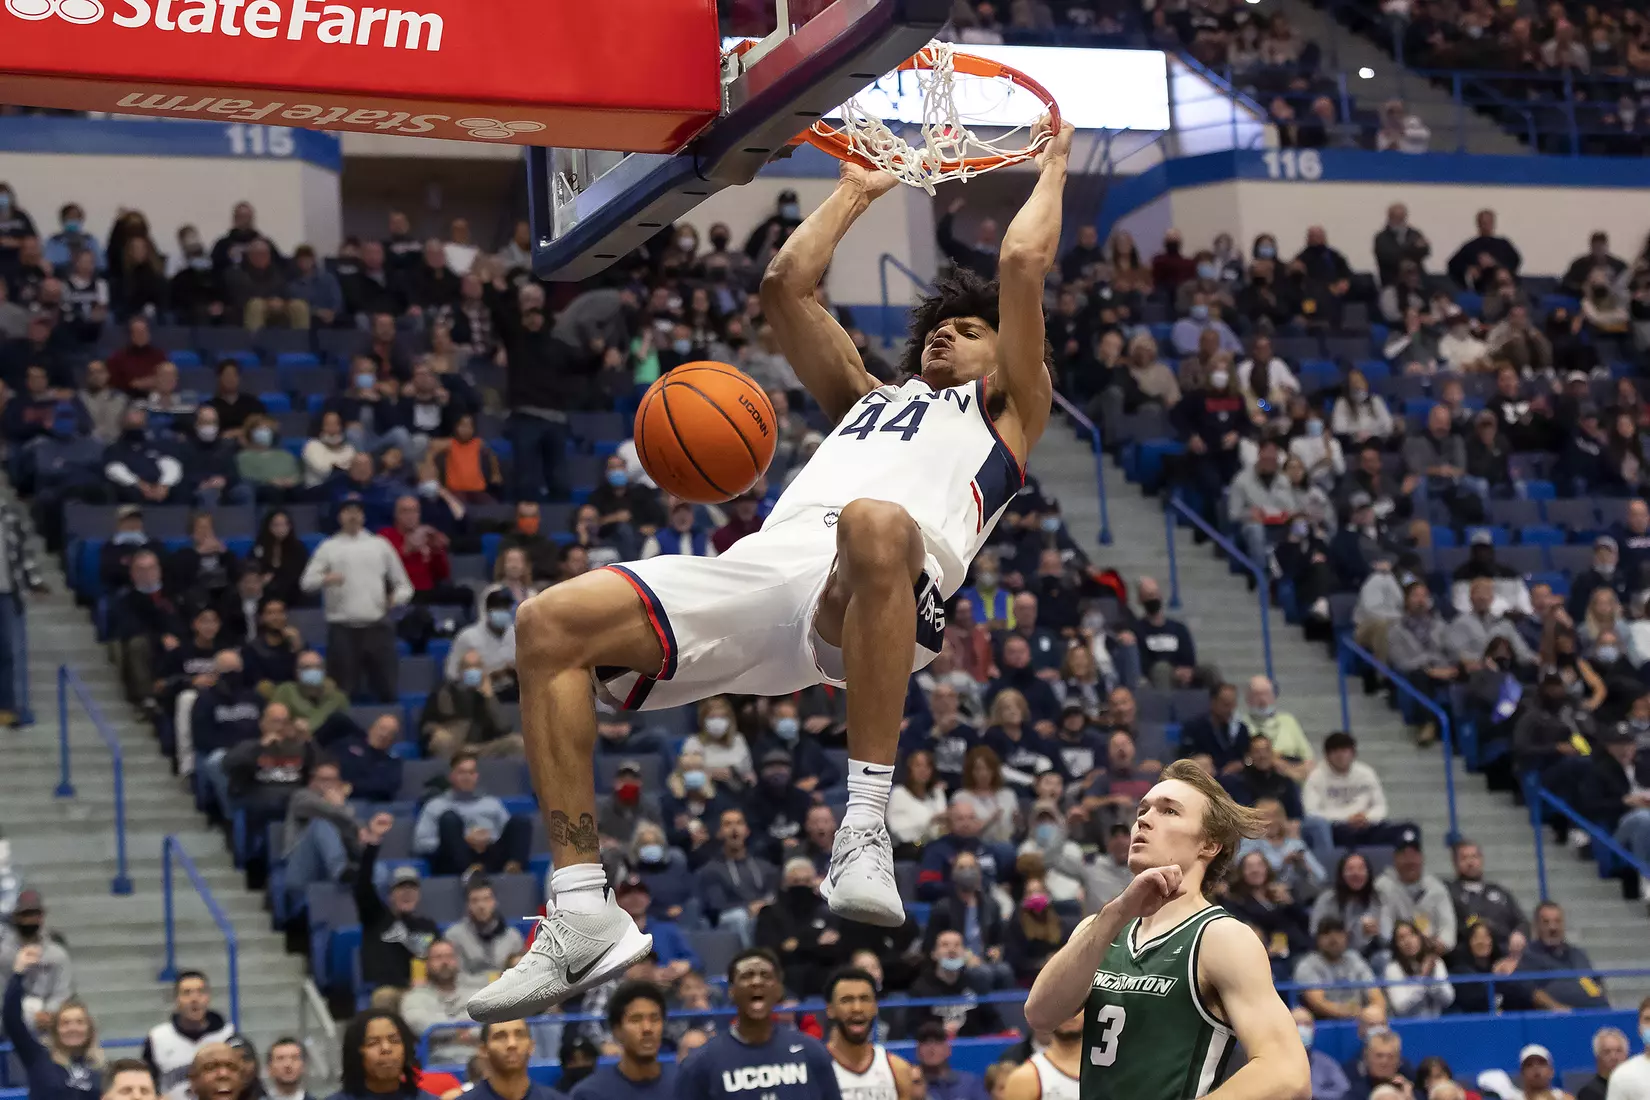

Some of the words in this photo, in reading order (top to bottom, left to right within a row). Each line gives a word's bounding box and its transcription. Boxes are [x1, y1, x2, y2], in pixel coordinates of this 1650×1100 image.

[113, 0, 280, 38] State
[287, 0, 443, 51] Farm
[116, 93, 276, 120] Farm
[282, 103, 450, 132] State
[226, 125, 296, 156] 115
[1263, 150, 1322, 179] 116
[738, 394, 769, 437] UCONN
[838, 400, 930, 441] 44
[1090, 1004, 1126, 1067] 3
[722, 1062, 808, 1093] UCONN
